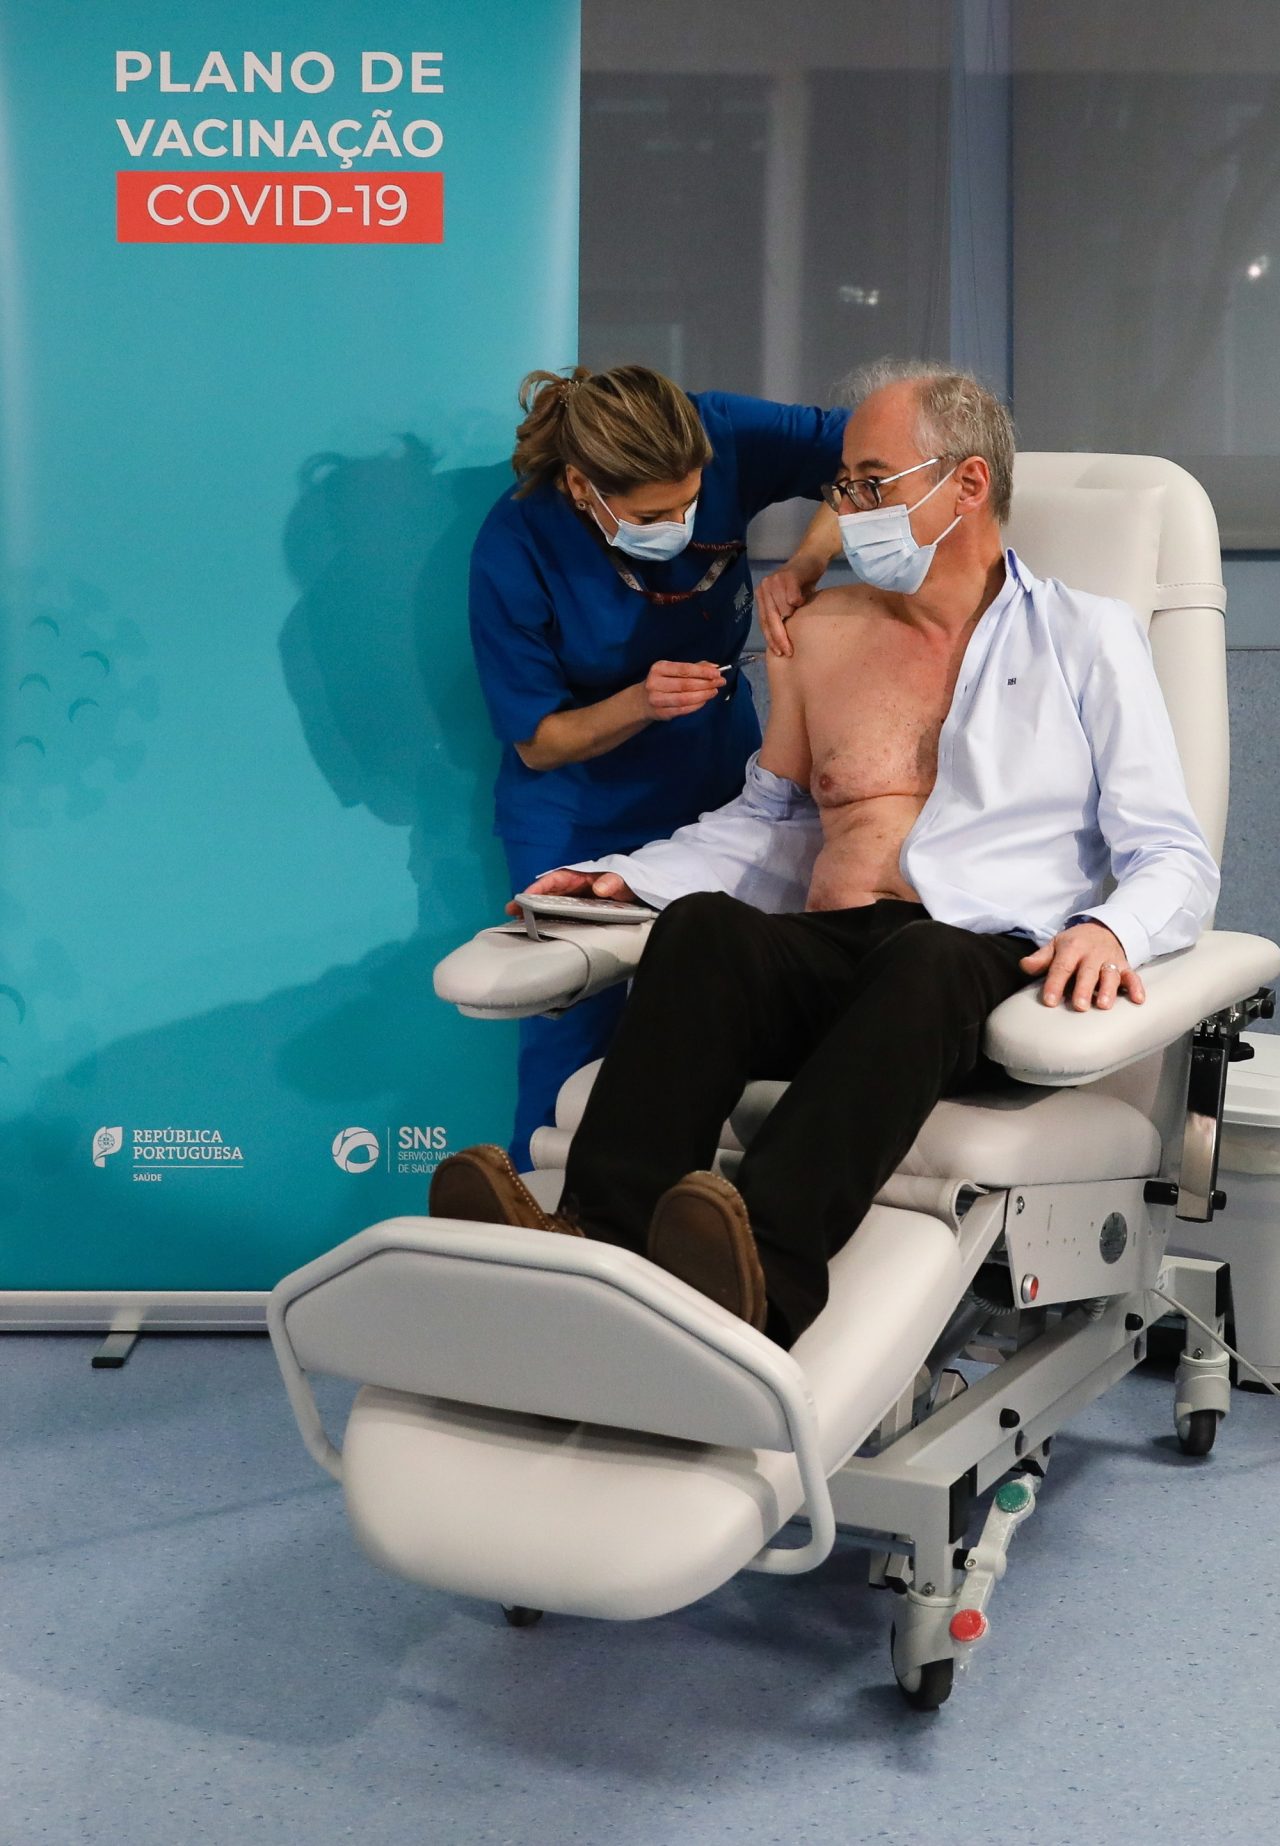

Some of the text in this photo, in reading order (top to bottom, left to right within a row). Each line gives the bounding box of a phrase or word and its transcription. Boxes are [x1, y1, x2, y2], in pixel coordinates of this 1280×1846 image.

[115, 50, 444, 94] PLANO DE
[115, 109, 444, 169] VACINAÇÃO
[147, 184, 408, 226] COVID-19
[132, 1126, 224, 1143] REPÚBLICA
[398, 1126, 447, 1150] SNS
[132, 1146, 244, 1160] PORTUGUESA
[398, 1151, 434, 1163] SERVIÇO
[132, 1172, 163, 1182] SAÚDE
[398, 1163, 409, 1174] DE
